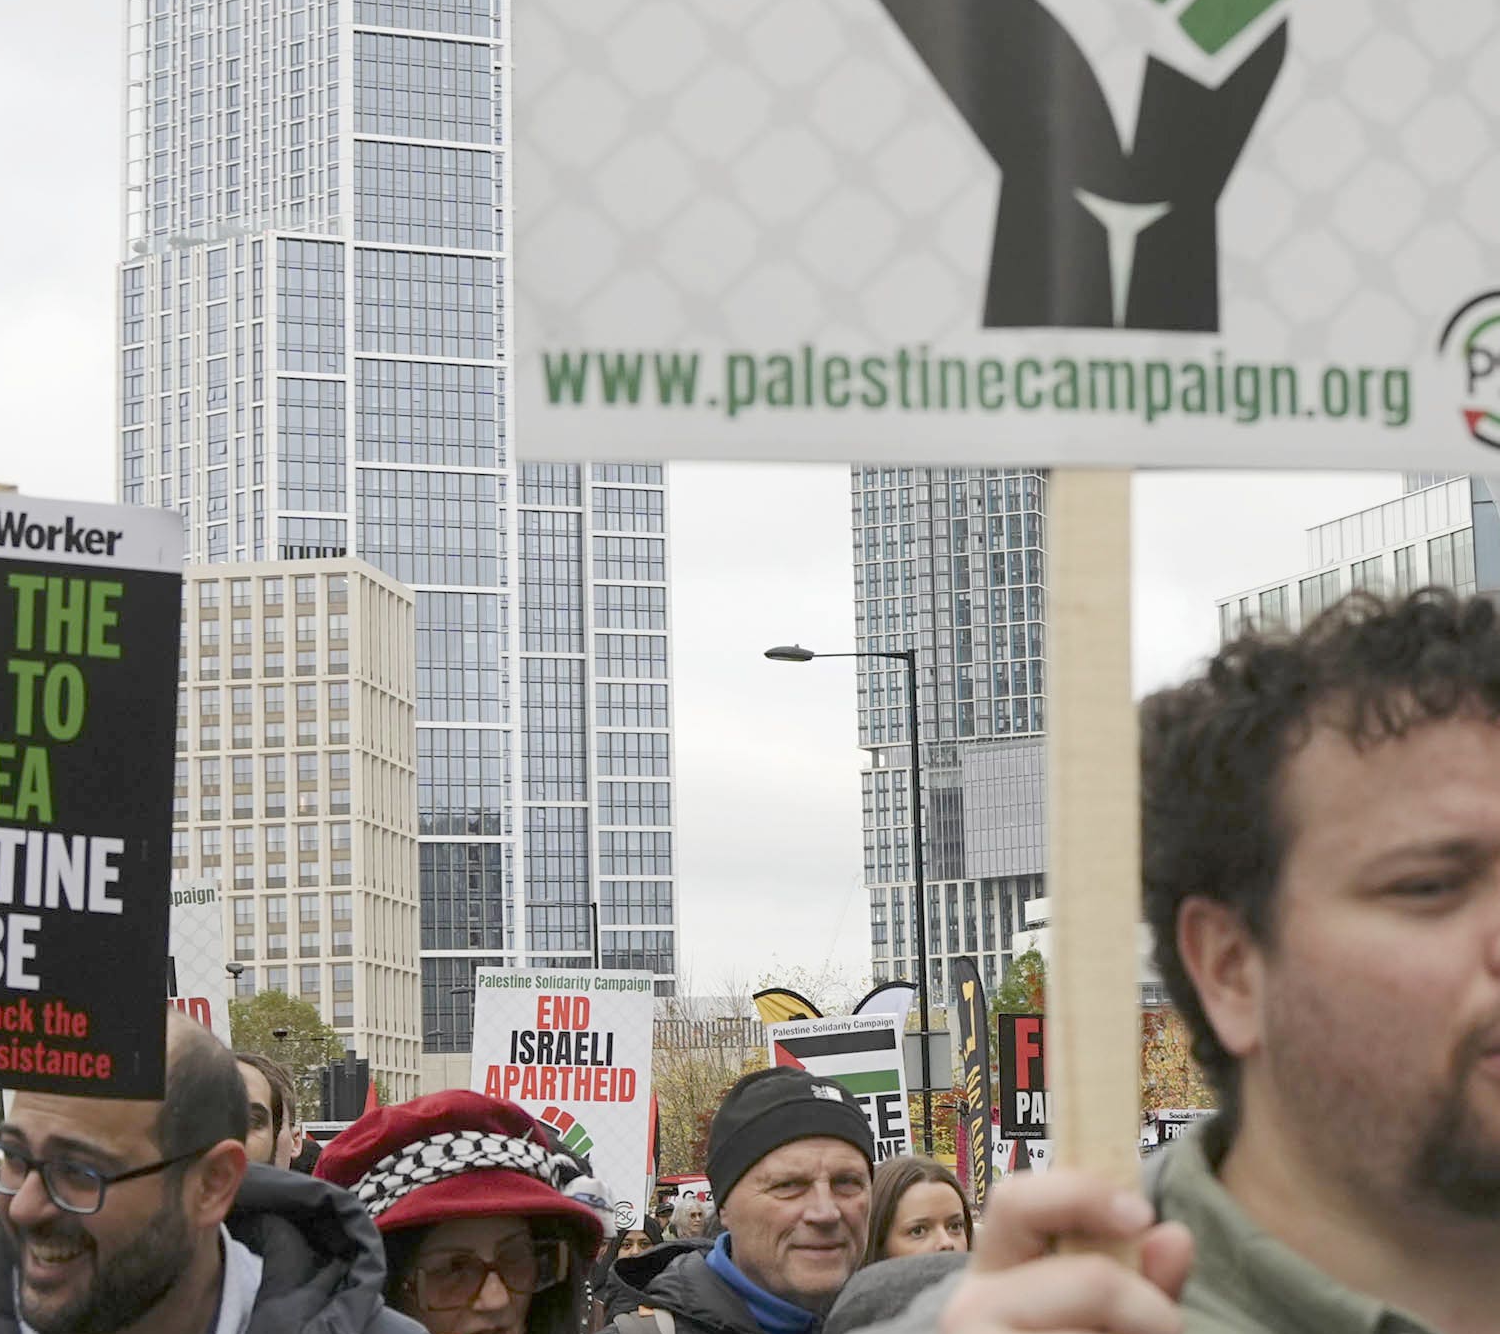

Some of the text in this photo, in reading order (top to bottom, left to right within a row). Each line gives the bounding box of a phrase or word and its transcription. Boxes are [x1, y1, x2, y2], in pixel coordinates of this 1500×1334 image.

[543, 344, 1413, 427] www.palestinecampaign.org
[8, 573, 124, 658] THE
[9, 659, 85, 740] TO
[479, 974, 650, 992] Palestine Solidarity Campaign
[43, 1001, 87, 1037] the
[536, 995, 590, 1031] END
[773, 1018, 894, 1036] Palestine Solidarity Campaign
[510, 1030, 613, 1066] ISRAELI
[484, 1065, 636, 1102] APARTHEID
